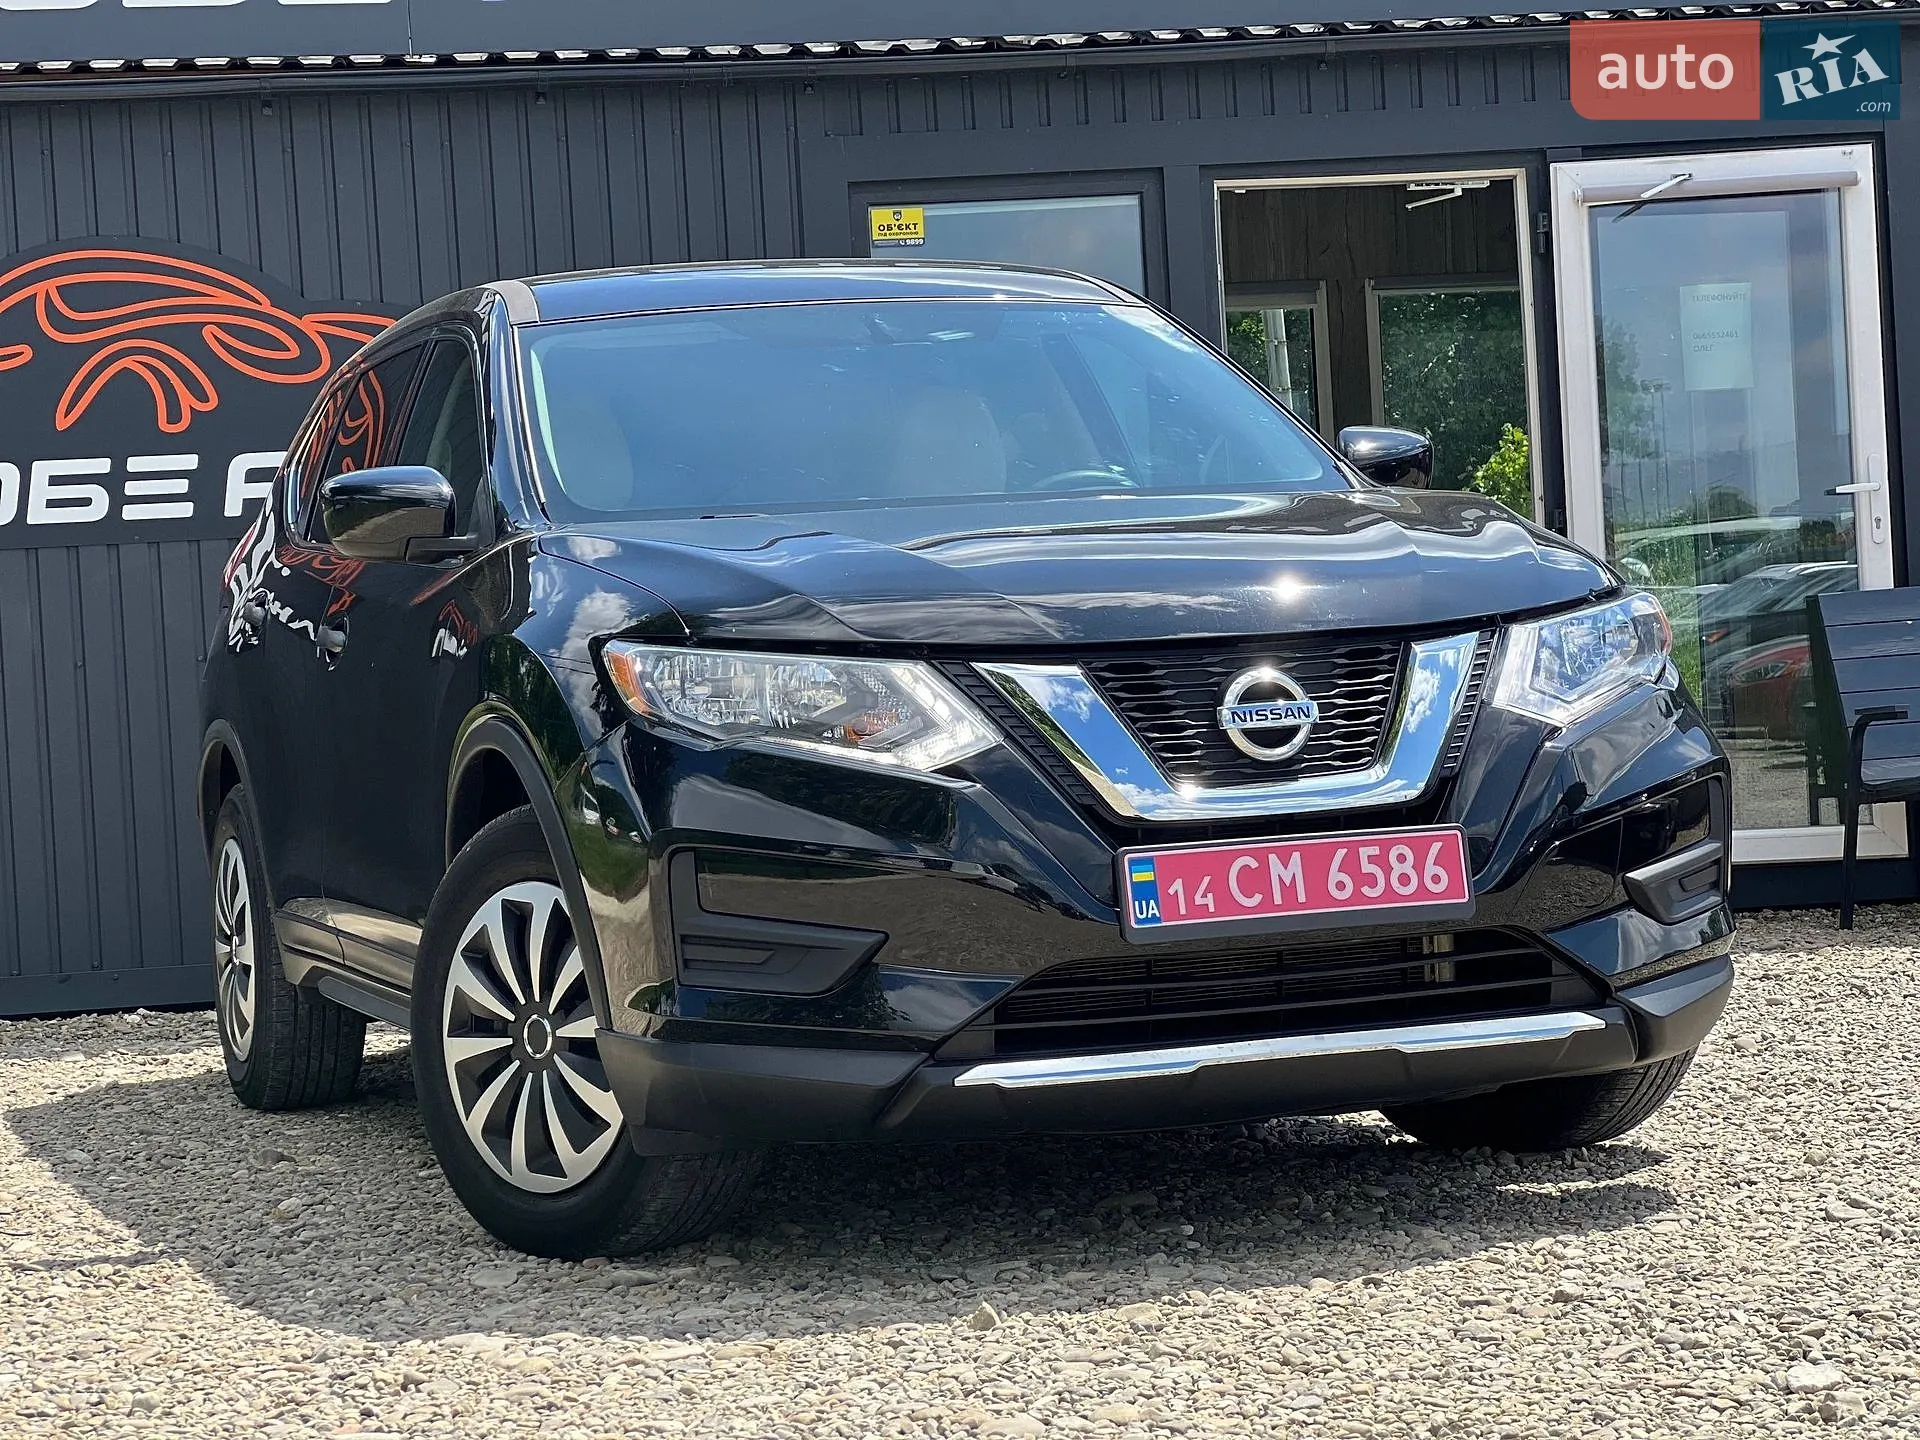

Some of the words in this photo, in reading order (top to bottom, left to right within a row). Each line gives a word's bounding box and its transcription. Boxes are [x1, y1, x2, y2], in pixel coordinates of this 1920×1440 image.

[0, 454, 199, 526] БЕ
[1231, 706, 1311, 723] NISSAN
[1168, 876, 1215, 915] 14
[1228, 851, 1306, 908] CM
[1327, 842, 1449, 900] 6586
[1135, 898, 1161, 920] UA
